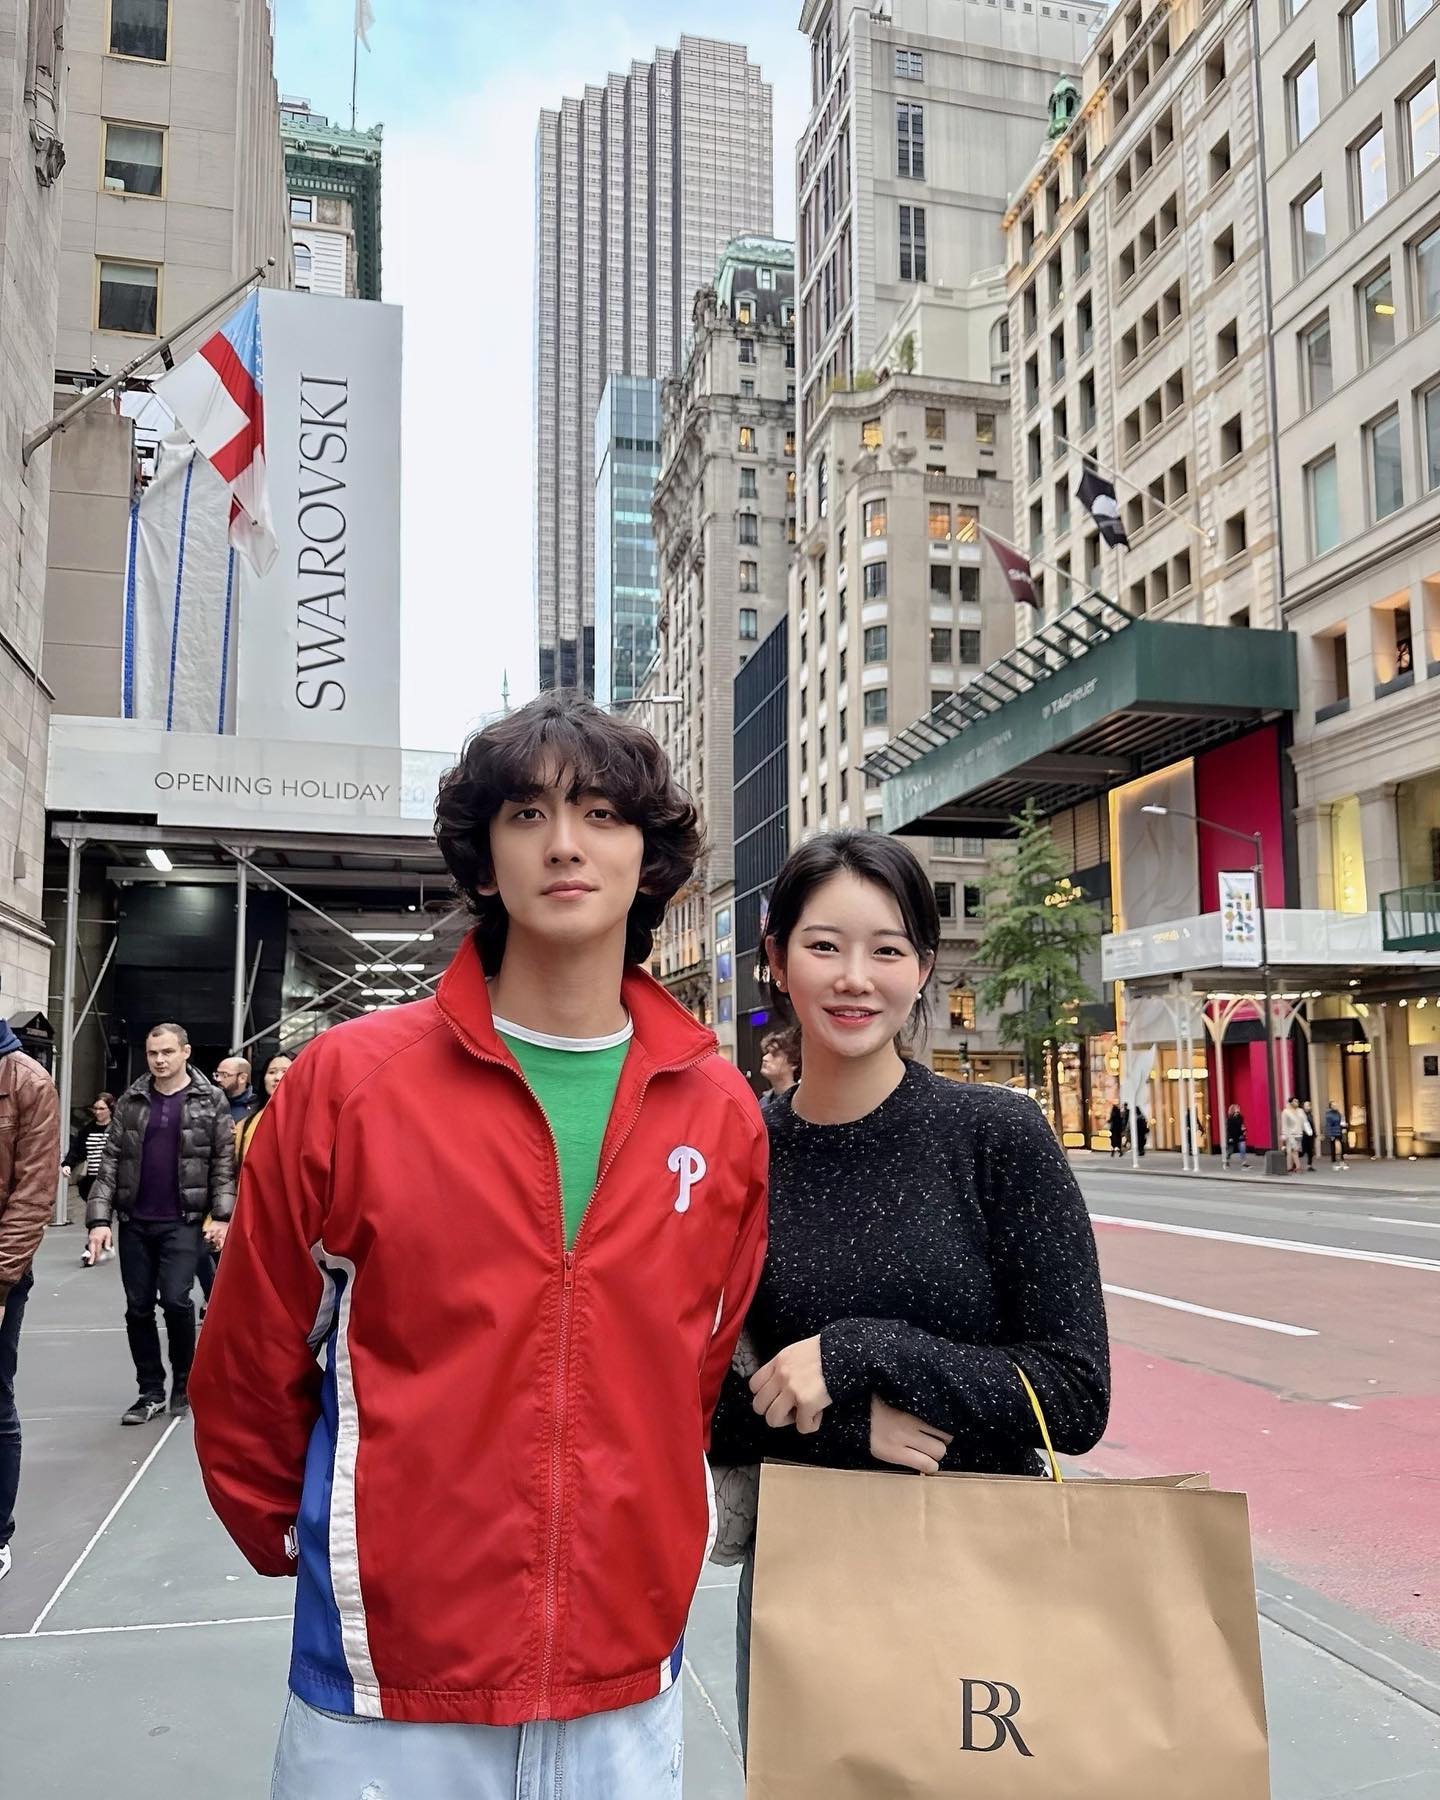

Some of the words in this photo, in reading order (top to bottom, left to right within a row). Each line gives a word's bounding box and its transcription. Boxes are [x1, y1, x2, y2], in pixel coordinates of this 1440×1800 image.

[296, 371, 348, 712] SWAROVSKI
[154, 771, 272, 796] OPENING
[281, 779, 391, 802] HOLIDAY
[667, 1145, 707, 1214] P
[959, 1678, 1035, 1757] BR
